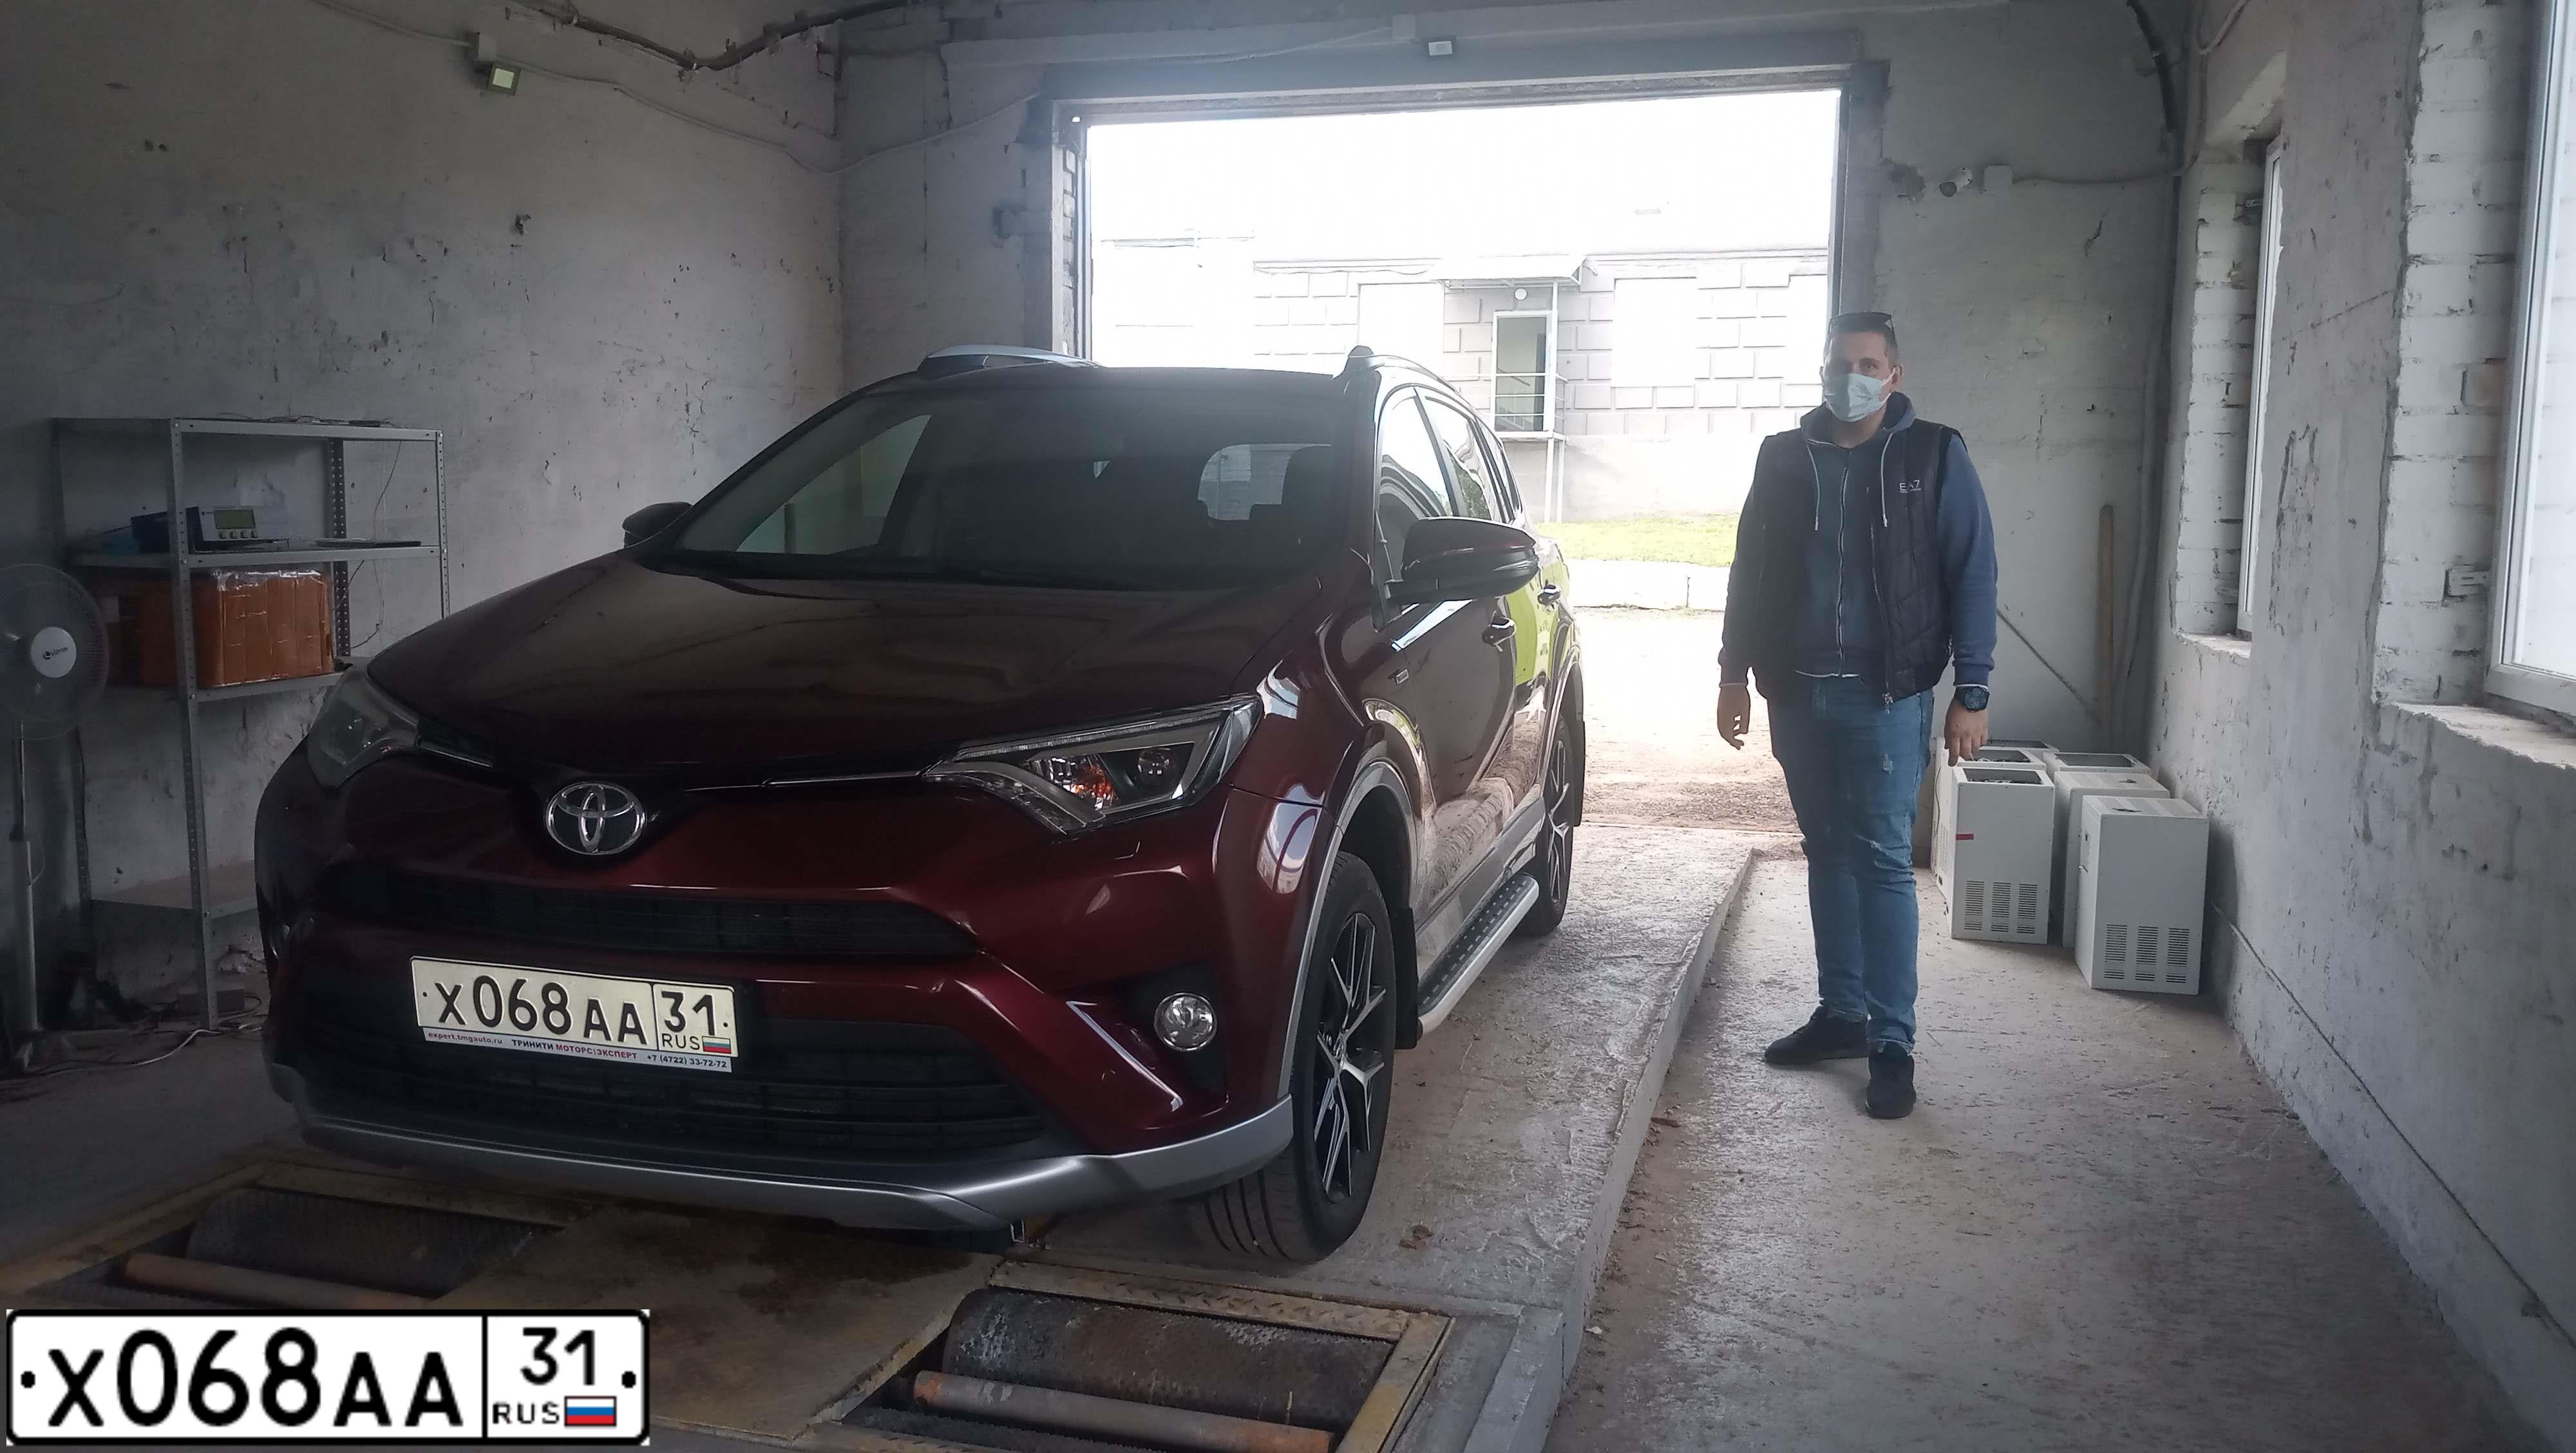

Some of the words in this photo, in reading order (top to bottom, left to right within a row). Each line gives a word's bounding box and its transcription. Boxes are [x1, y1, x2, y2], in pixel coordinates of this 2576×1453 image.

[661, 990, 717, 1036] 31
[428, 1032, 503, 1045] expert.tmgauto.ru
[511, 1039, 554, 1050] ТРИНИТИ
[661, 1033, 700, 1050] RUS
[659, 1054, 687, 1065] (4722)
[690, 1058, 727, 1068] 33-72-72
